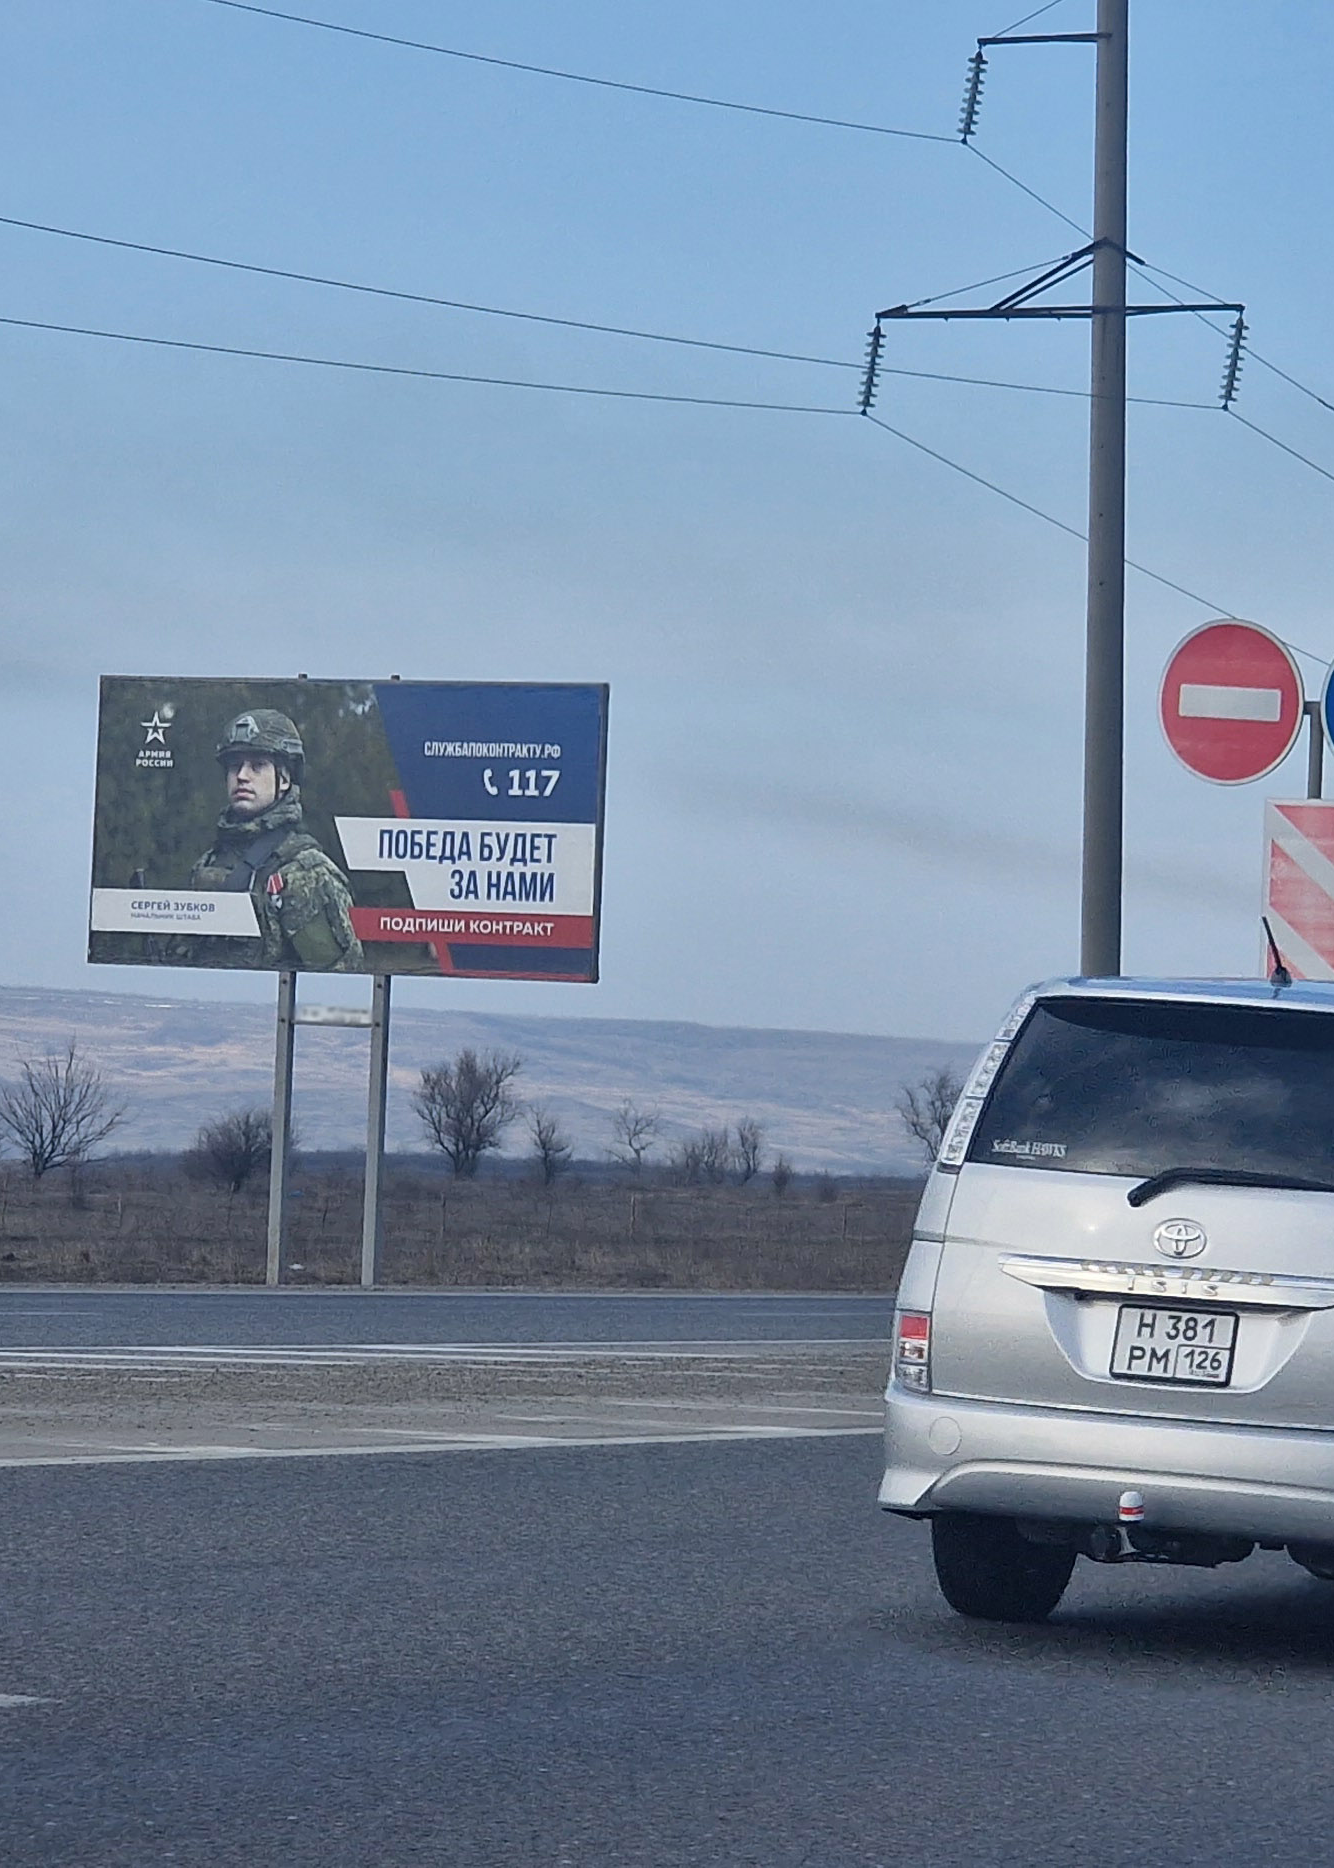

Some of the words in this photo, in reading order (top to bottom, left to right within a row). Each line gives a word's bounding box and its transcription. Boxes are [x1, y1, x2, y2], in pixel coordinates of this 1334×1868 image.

[136, 759, 173, 767] РОССИИ
[424, 741, 562, 759] СЛУЖБАПОКОНТРАКТУ.РФ
[508, 769, 561, 796] 117
[378, 829, 472, 864] ПОБЕДА
[479, 832, 557, 867] БУДЕТ
[449, 869, 479, 900] ЗА
[486, 870, 555, 902] НАМИ
[131, 900, 170, 910] СЕРГЕЙ
[174, 902, 216, 912] ЗУБКОВ
[380, 917, 465, 934] ПОДПИШИ
[469, 920, 554, 936] КОНТРАКТ
[1165, 1315, 1217, 1343] 381
[1127, 1345, 1171, 1373] РМ
[1184, 1349, 1222, 1371] 126
